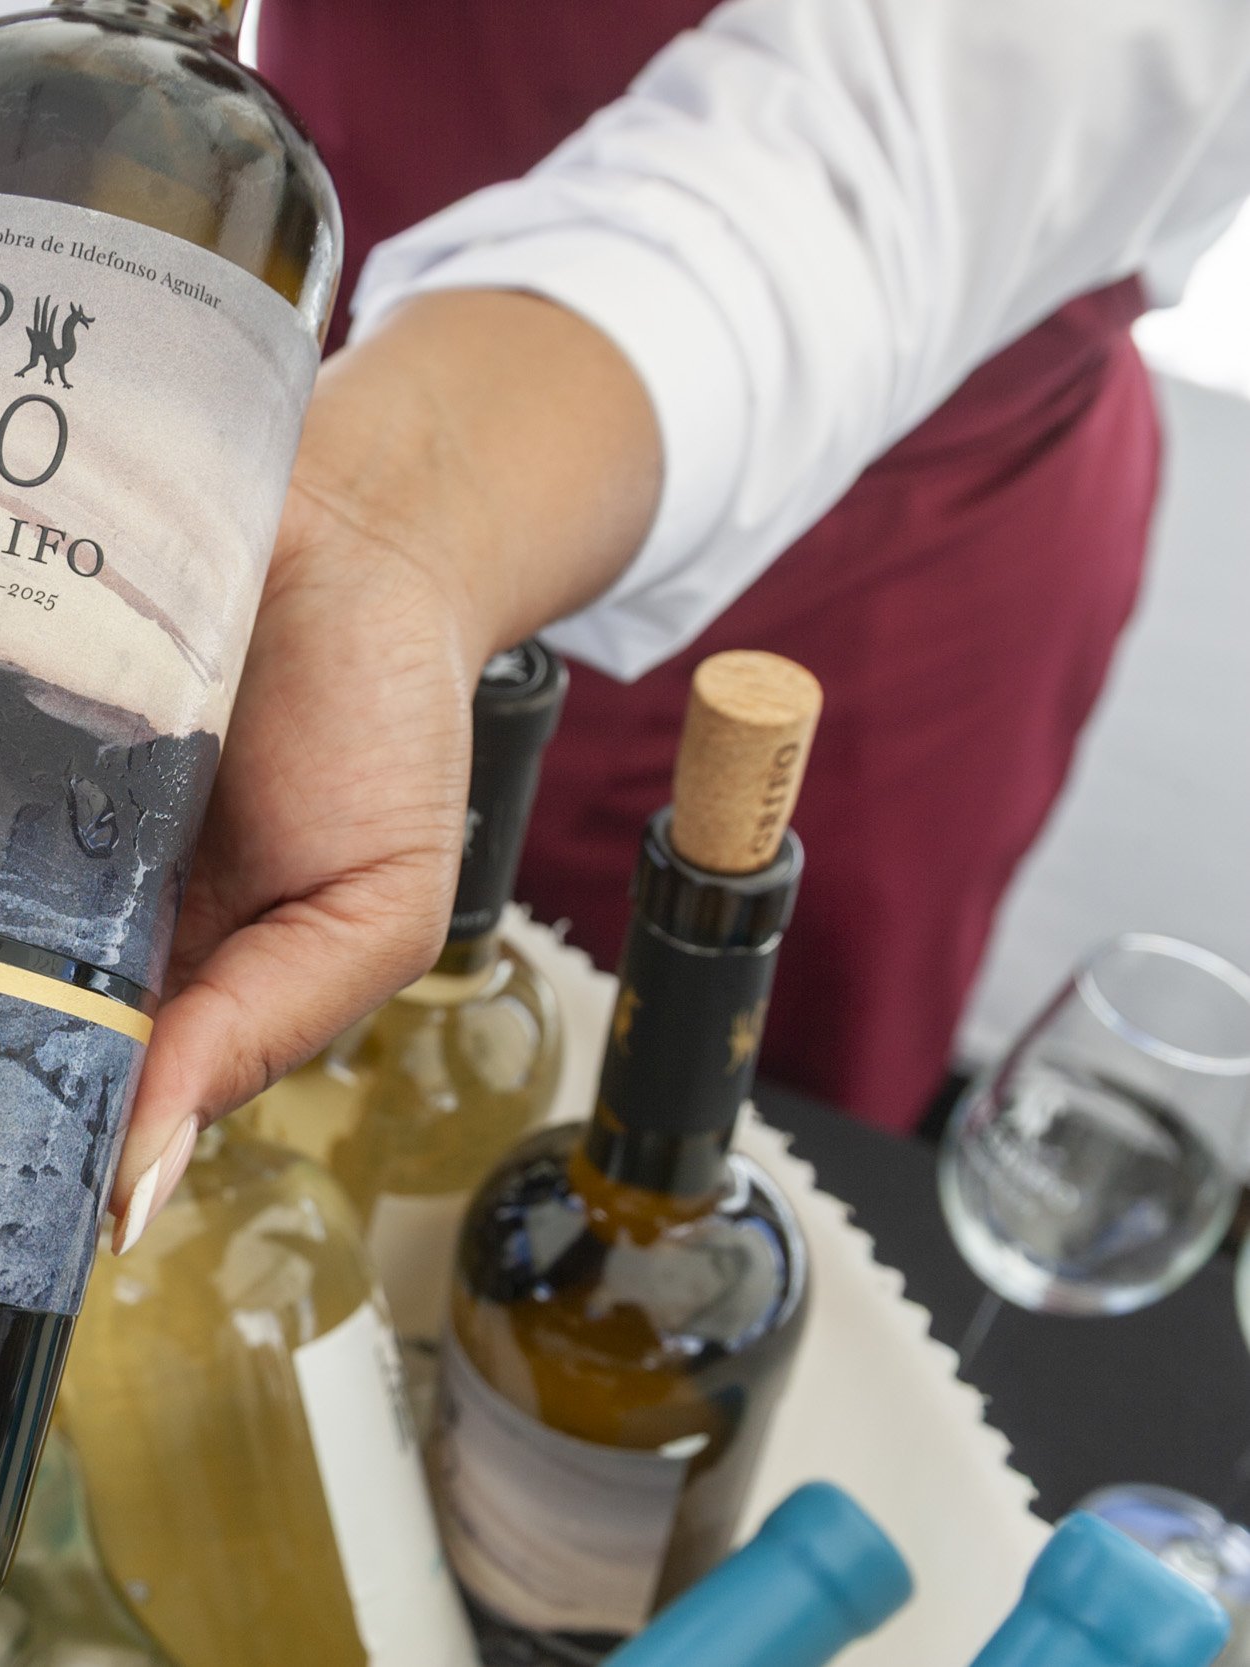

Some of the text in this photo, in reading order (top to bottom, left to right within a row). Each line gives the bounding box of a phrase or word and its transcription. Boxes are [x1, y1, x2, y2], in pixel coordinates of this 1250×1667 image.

[41, 235, 64, 254] de
[70, 241, 157, 281] Ildefonso
[160, 272, 221, 309] Aguilar
